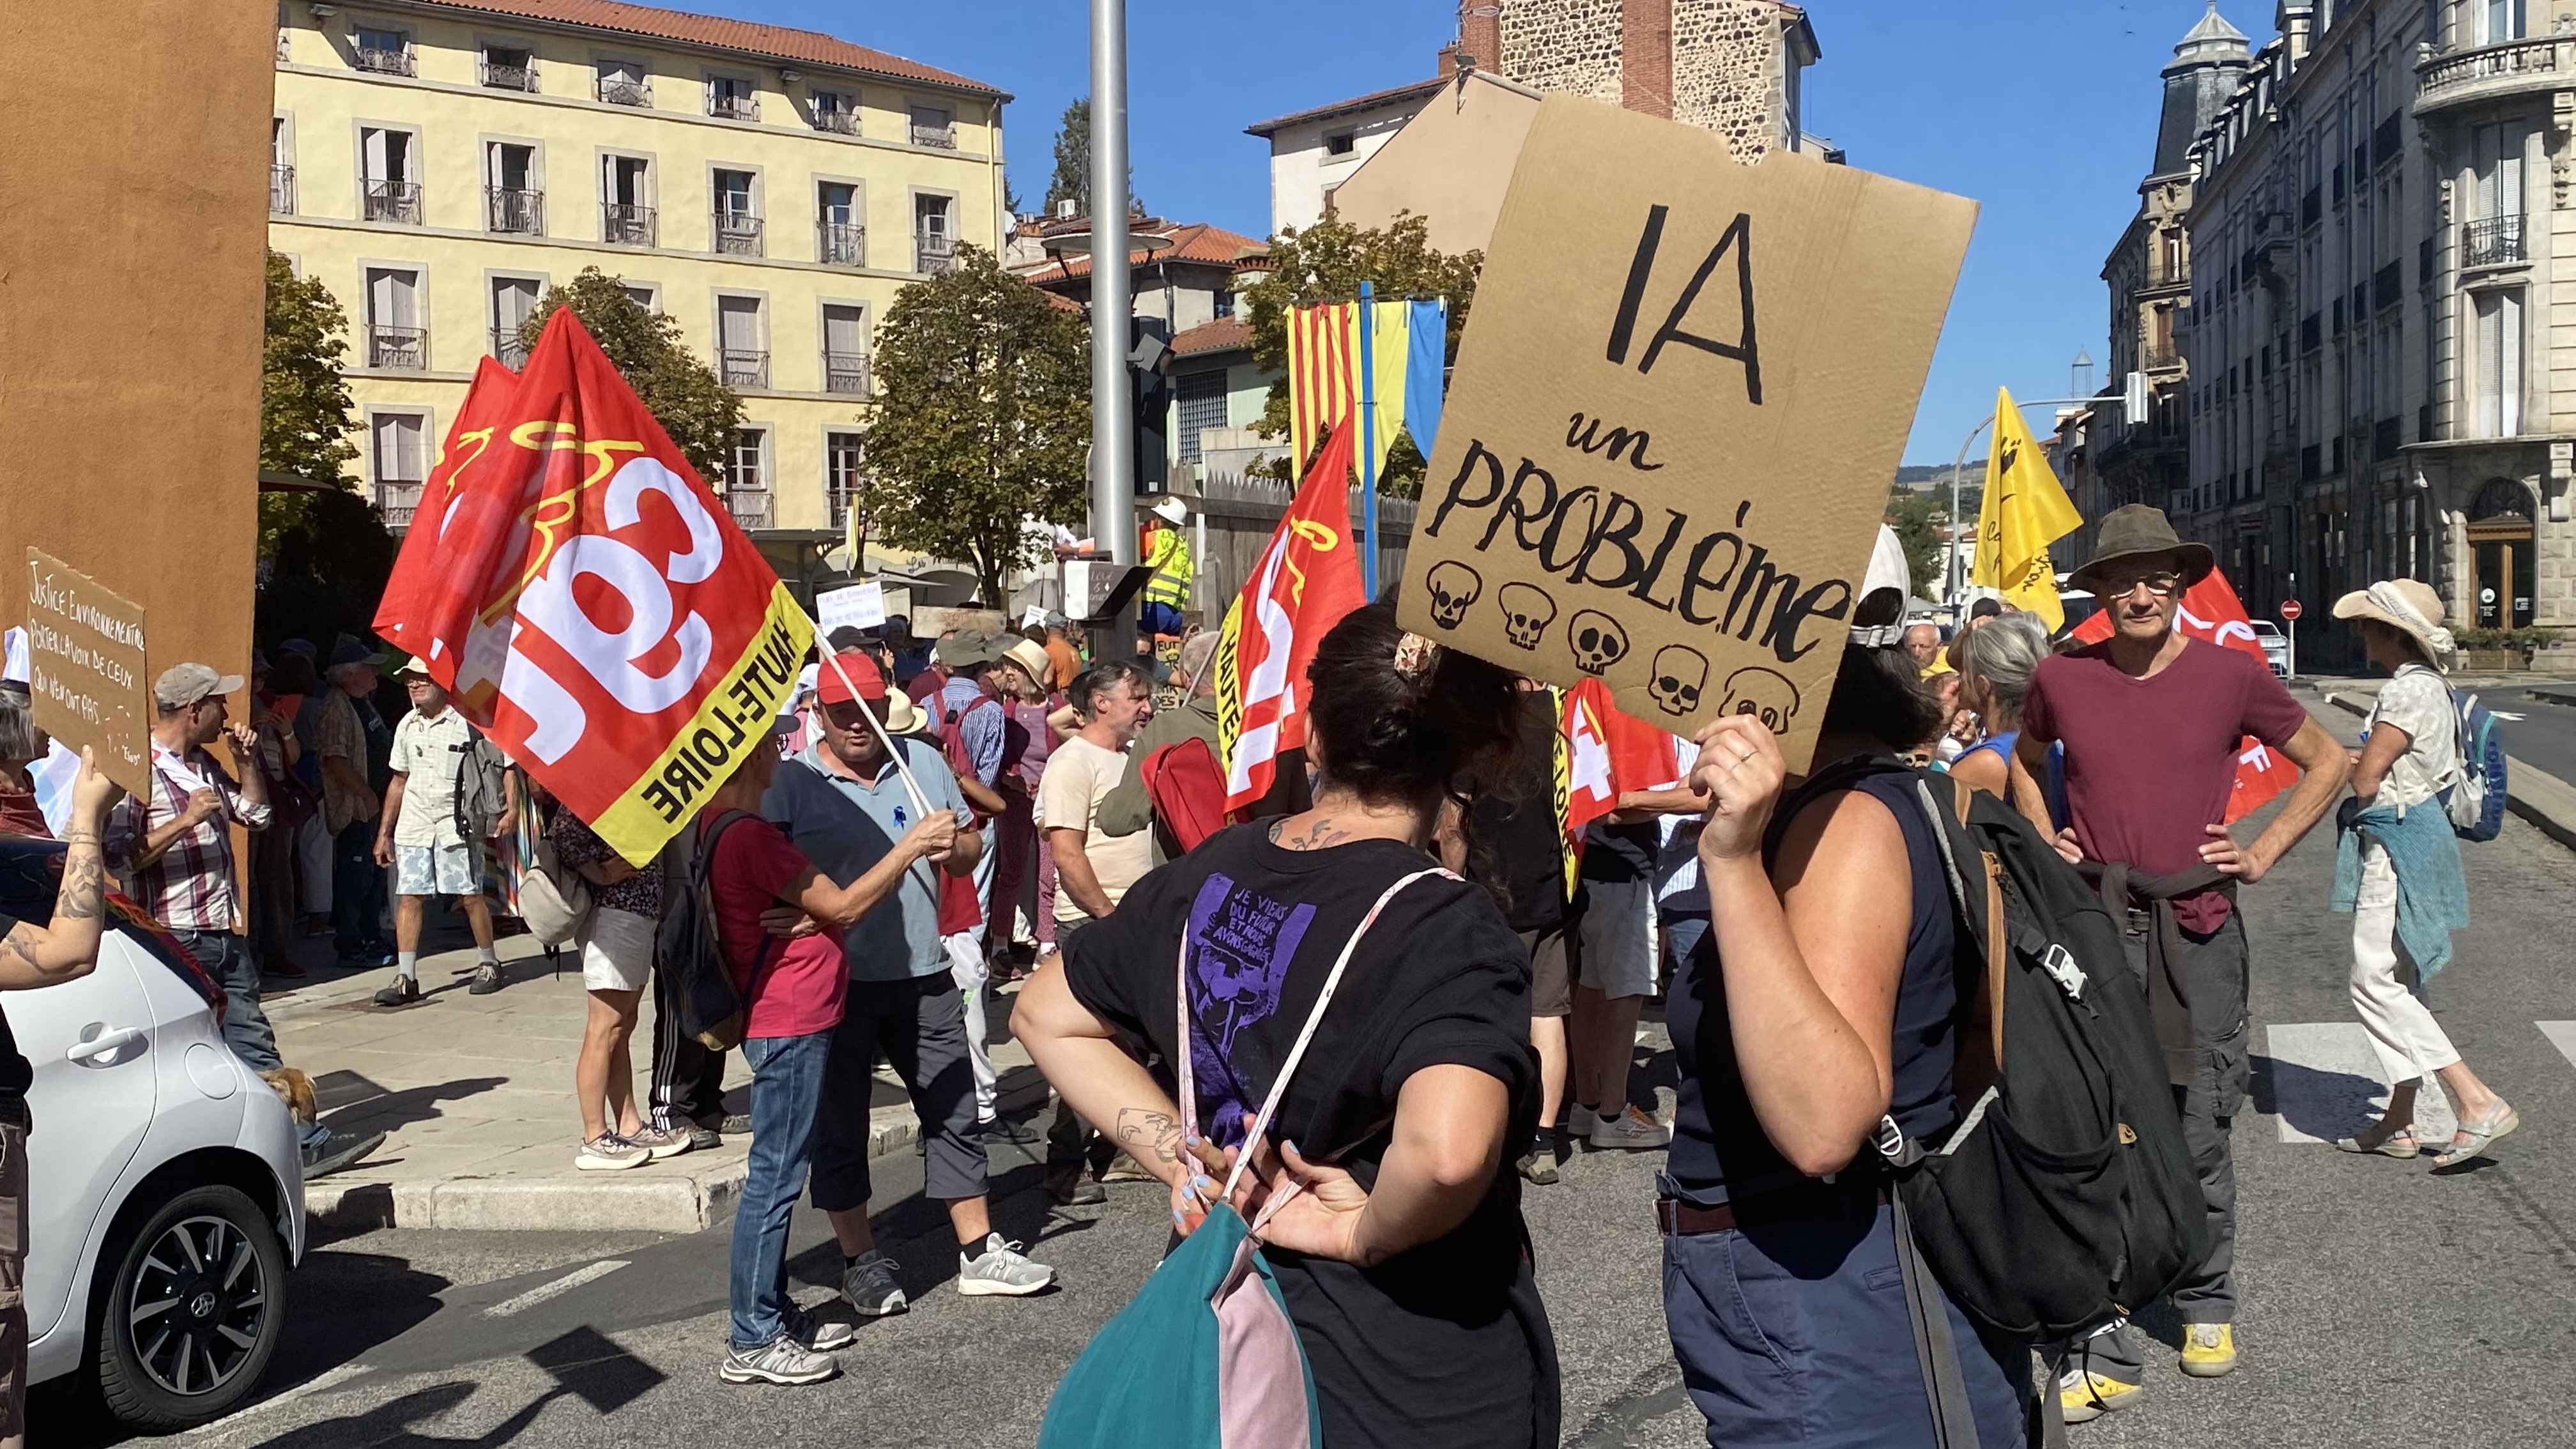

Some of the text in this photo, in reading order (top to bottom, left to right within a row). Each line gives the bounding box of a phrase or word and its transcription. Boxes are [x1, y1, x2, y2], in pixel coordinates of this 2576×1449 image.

[1606, 204, 1761, 405] IA
[1566, 413, 1664, 470] un
[30, 560, 65, 615] JUSTICE
[93, 649, 105, 676] DE
[107, 660, 133, 691] CEUX
[1229, 901, 1246, 920] DU
[1235, 888, 1252, 905] JE
[1229, 917, 1245, 931] ET
